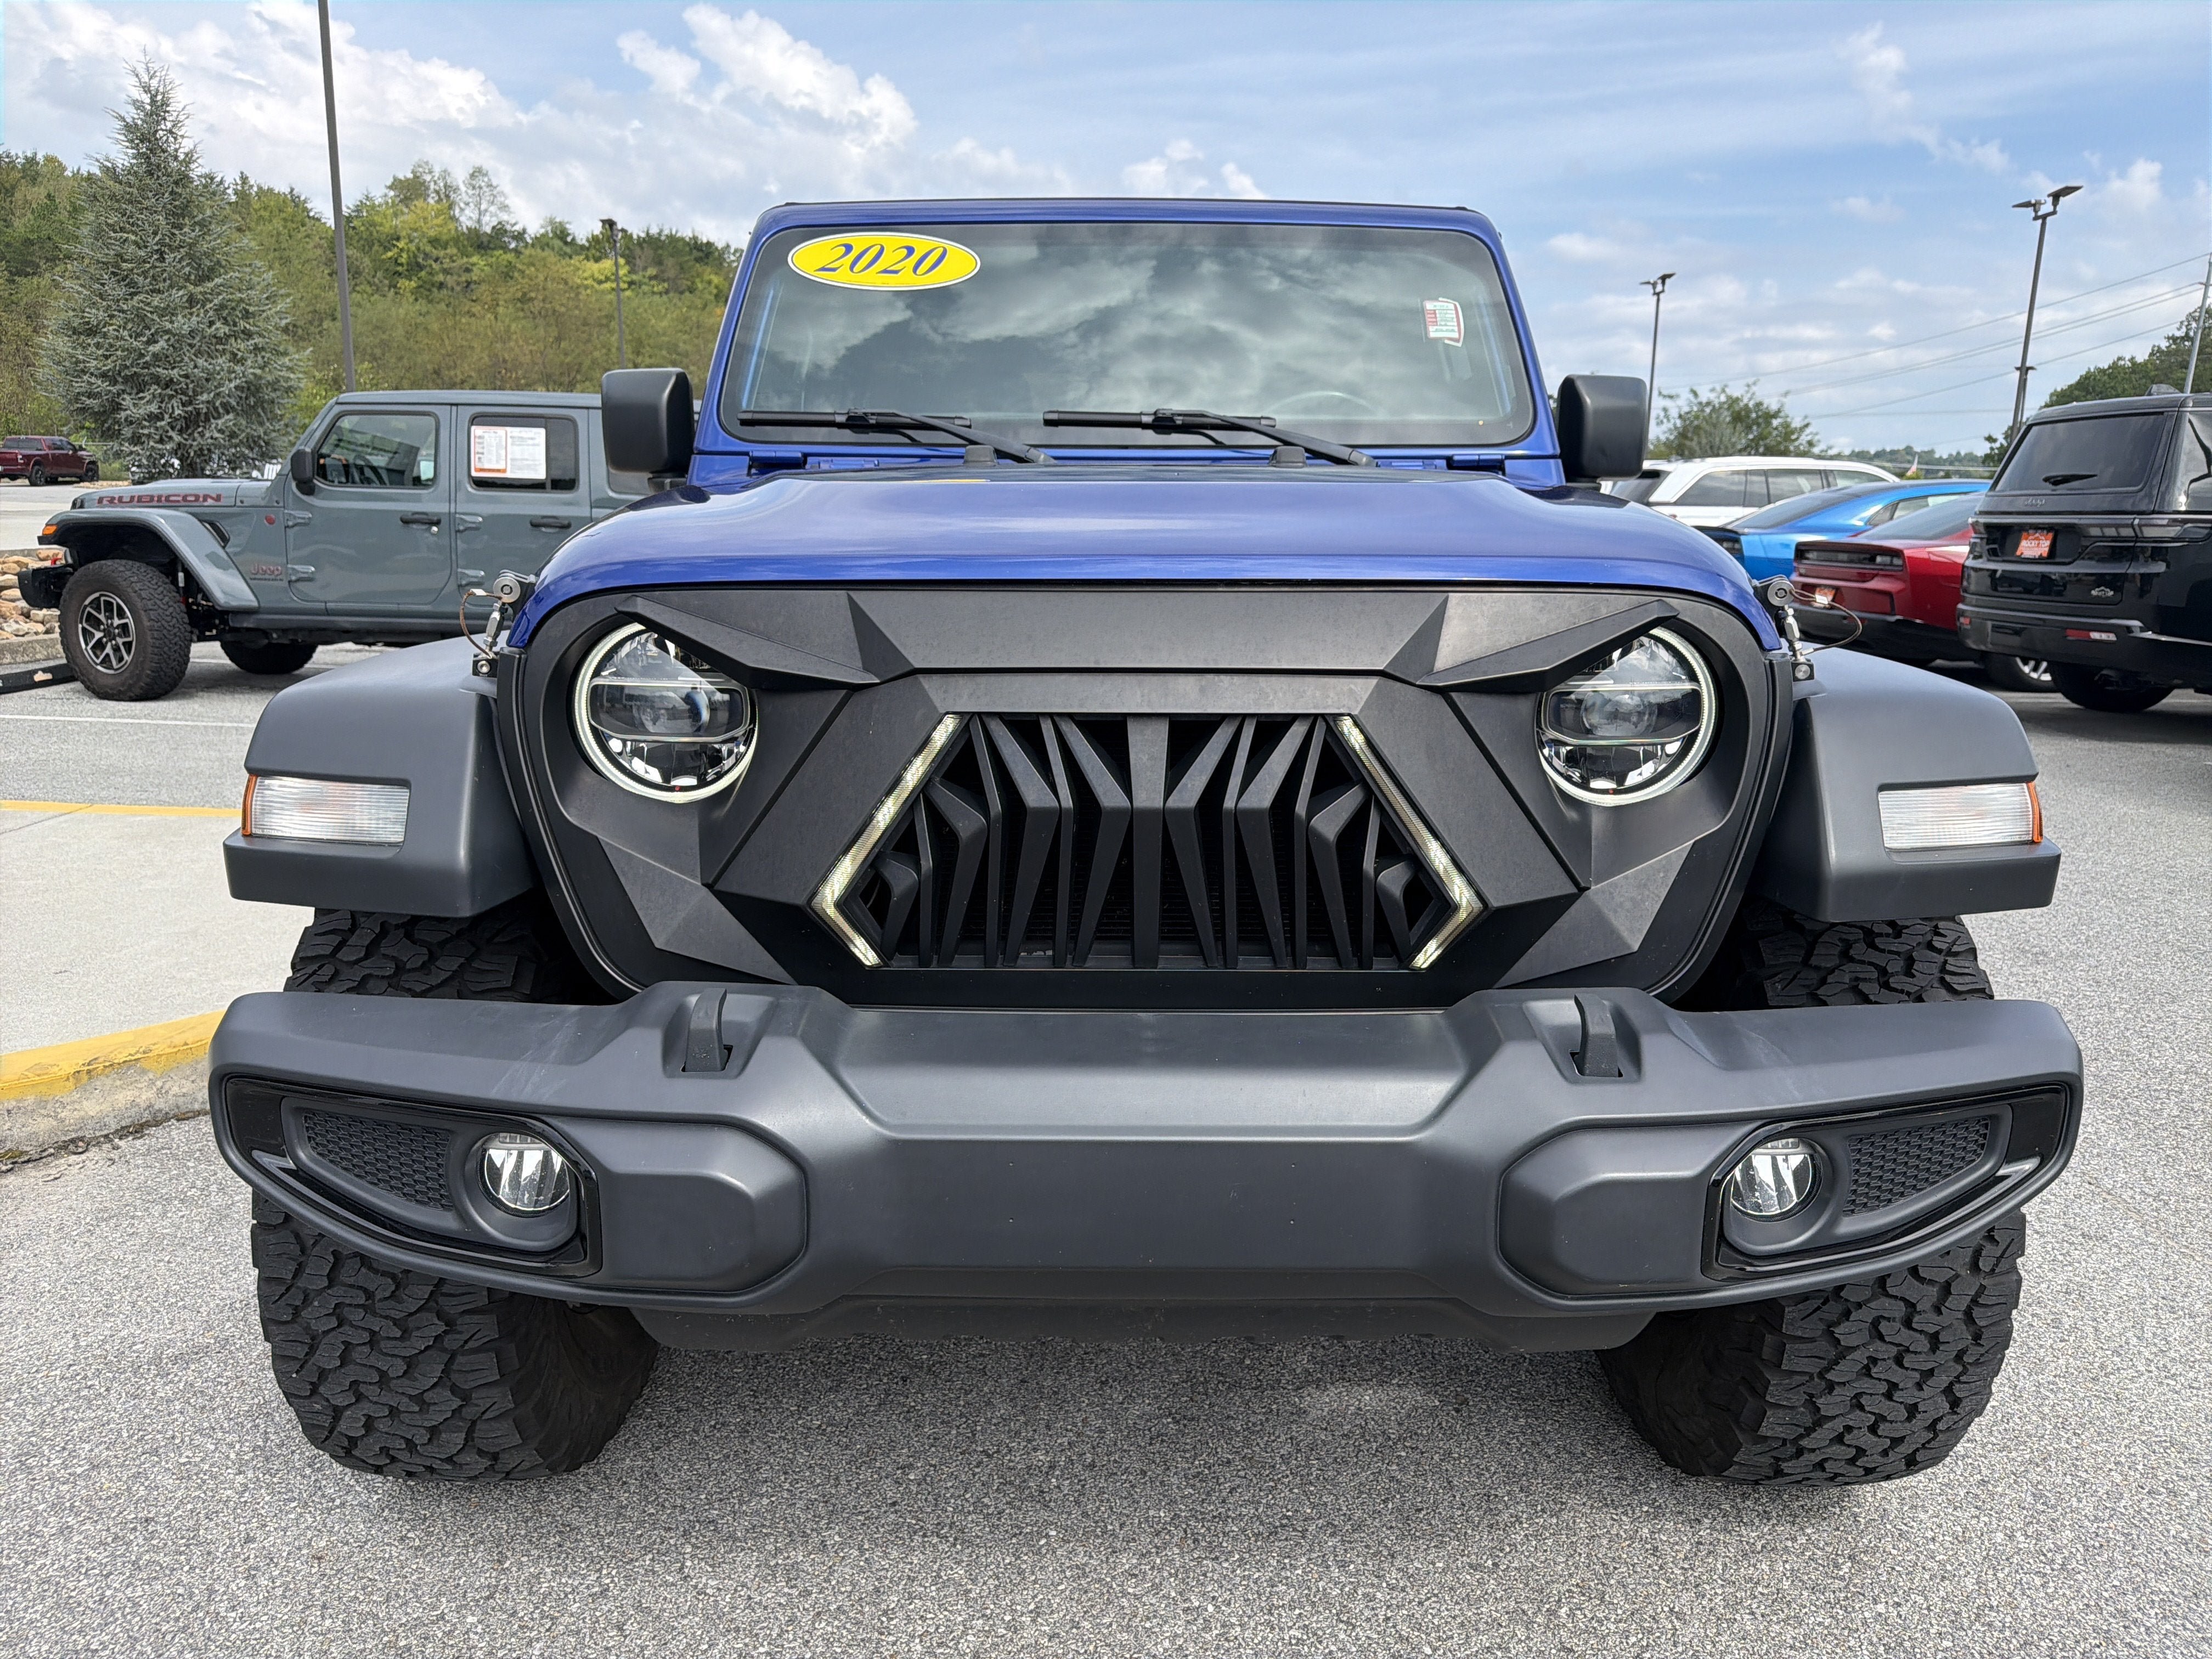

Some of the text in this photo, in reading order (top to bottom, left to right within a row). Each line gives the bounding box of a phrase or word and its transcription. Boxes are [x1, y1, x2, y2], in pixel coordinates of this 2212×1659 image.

[813, 243, 948, 276] 2020
[97, 493, 223, 505] RUBICON
[251, 563, 281, 576] Jeep
